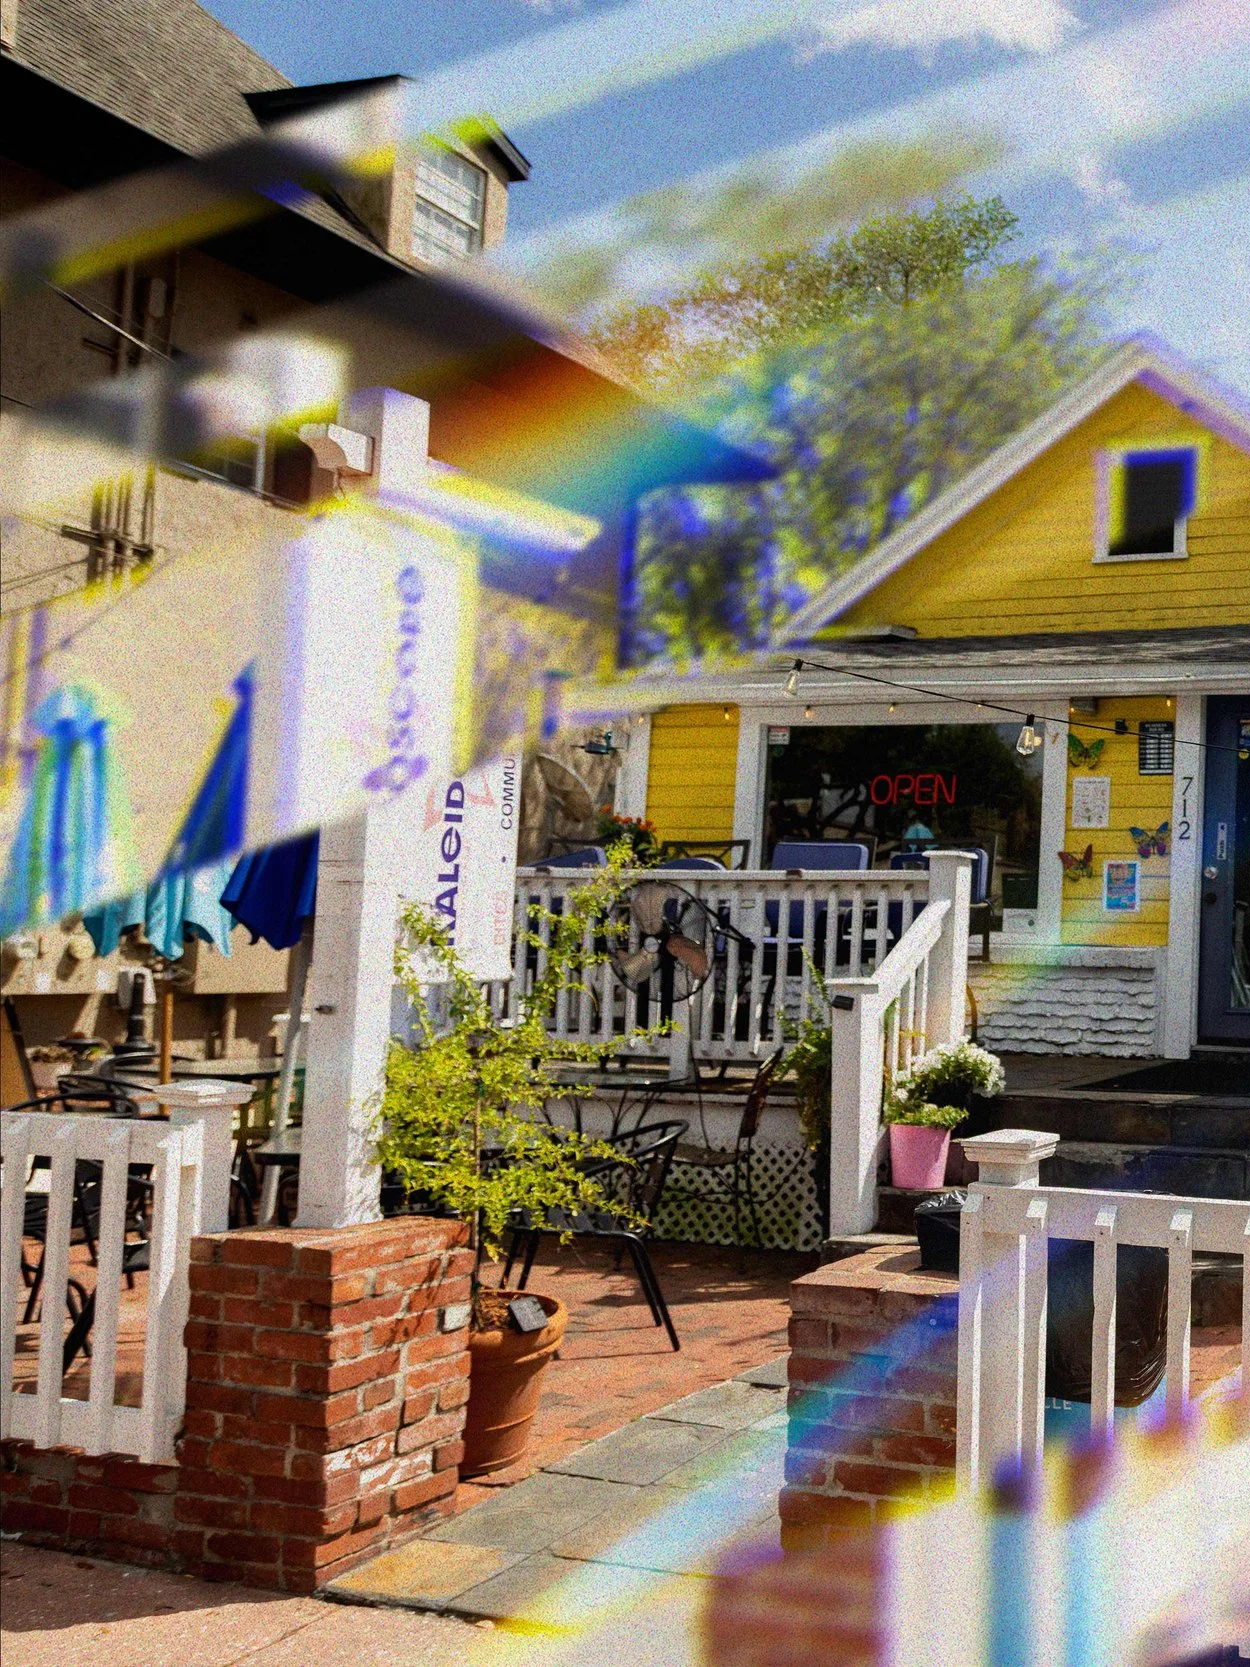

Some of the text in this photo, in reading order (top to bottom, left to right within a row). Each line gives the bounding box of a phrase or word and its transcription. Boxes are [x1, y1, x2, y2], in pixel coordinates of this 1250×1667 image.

[501, 757, 517, 831] COMMU
[870, 773, 957, 805] OPEN
[1178, 776, 1194, 840] 712
